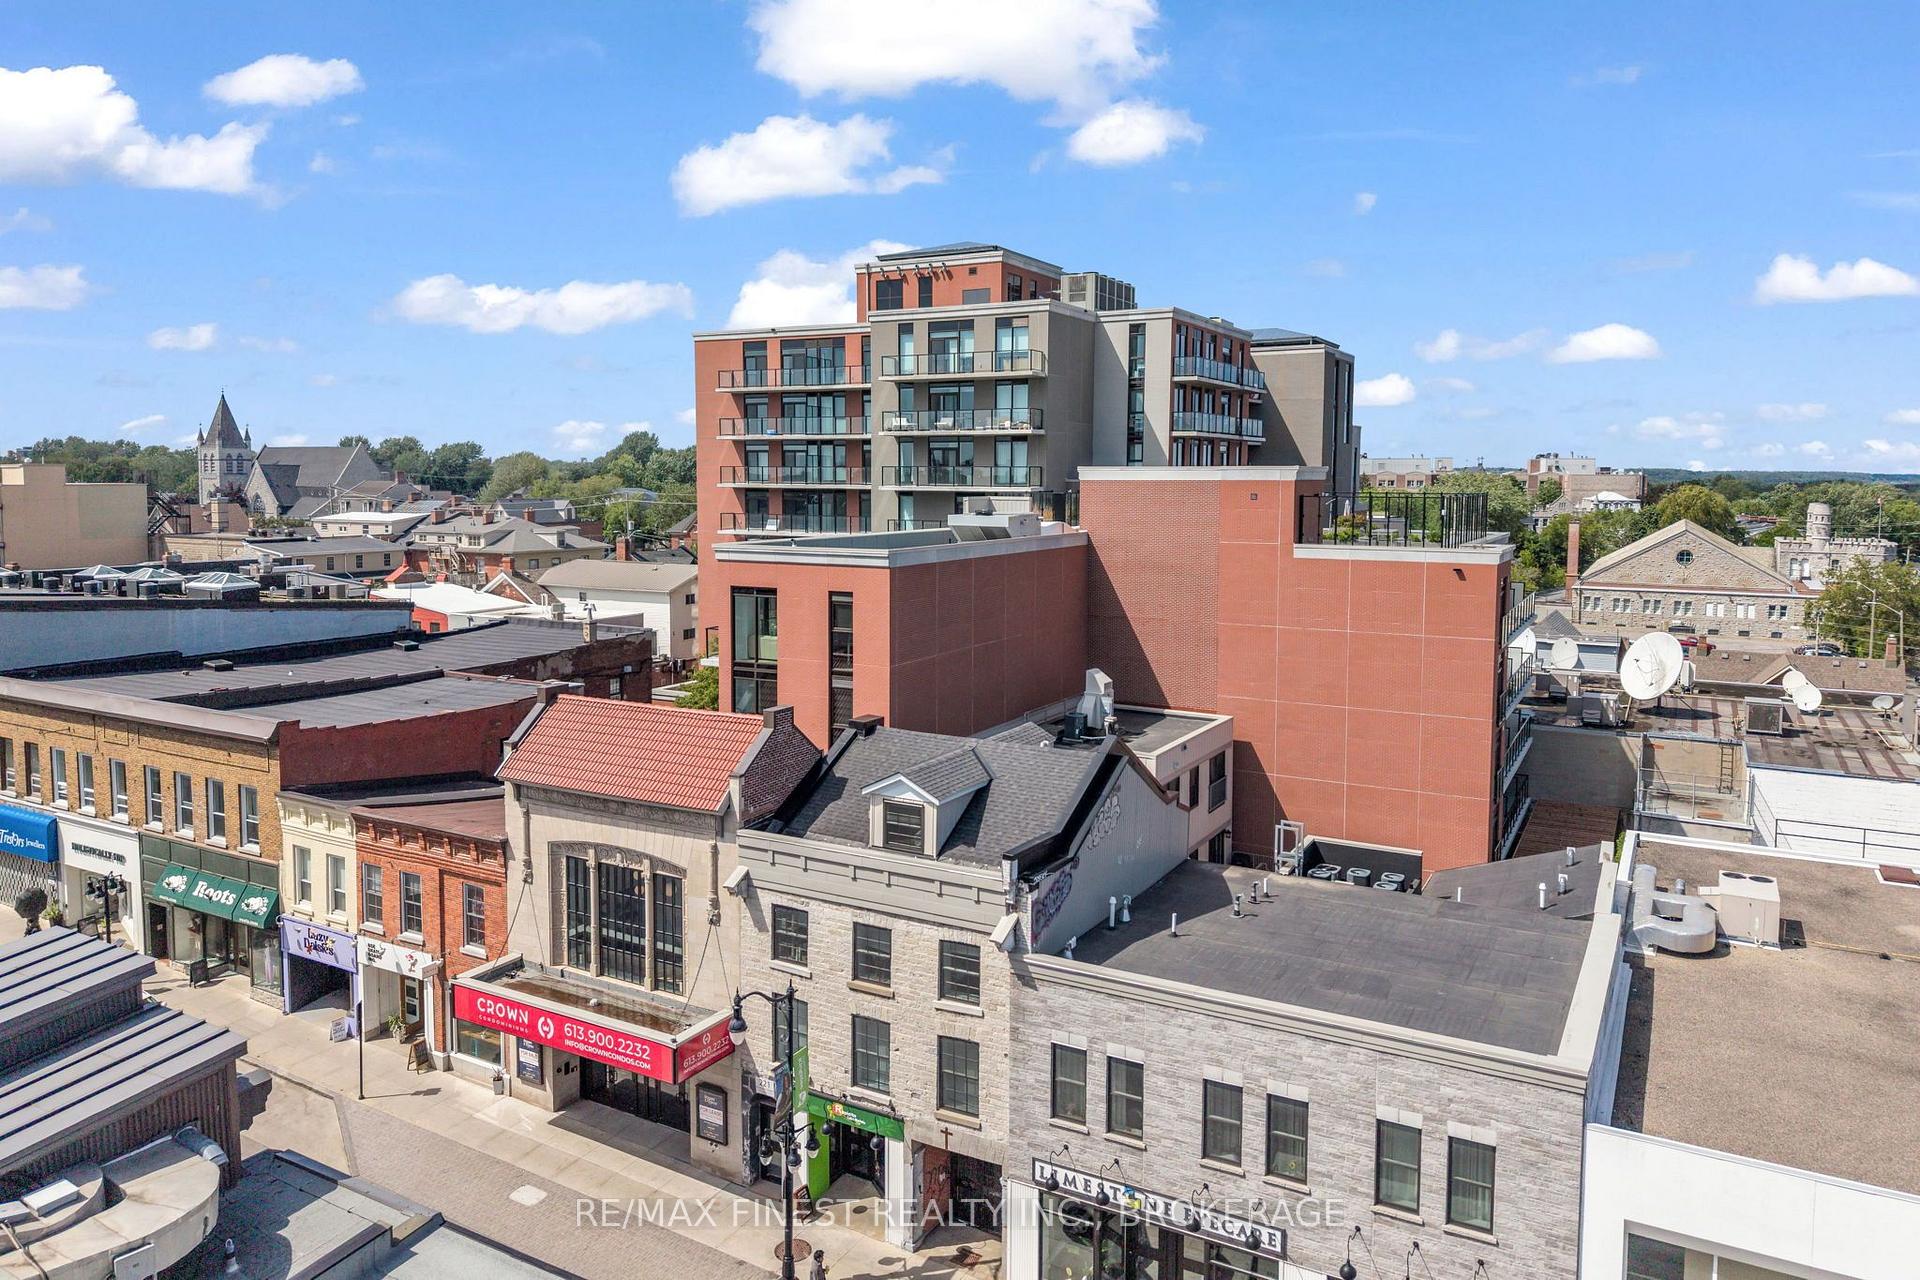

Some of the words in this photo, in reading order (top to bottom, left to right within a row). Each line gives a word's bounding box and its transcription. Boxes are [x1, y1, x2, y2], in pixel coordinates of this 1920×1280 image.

[192, 881, 237, 905] Roots
[308, 927, 329, 942] Lazy
[477, 997, 529, 1025] CROWN
[563, 1023, 651, 1061] 613.900.2232
[564, 1038, 651, 1070] INFO@CROWNCONDOS.COM
[1039, 1165, 1172, 1217] LIMESTNE
